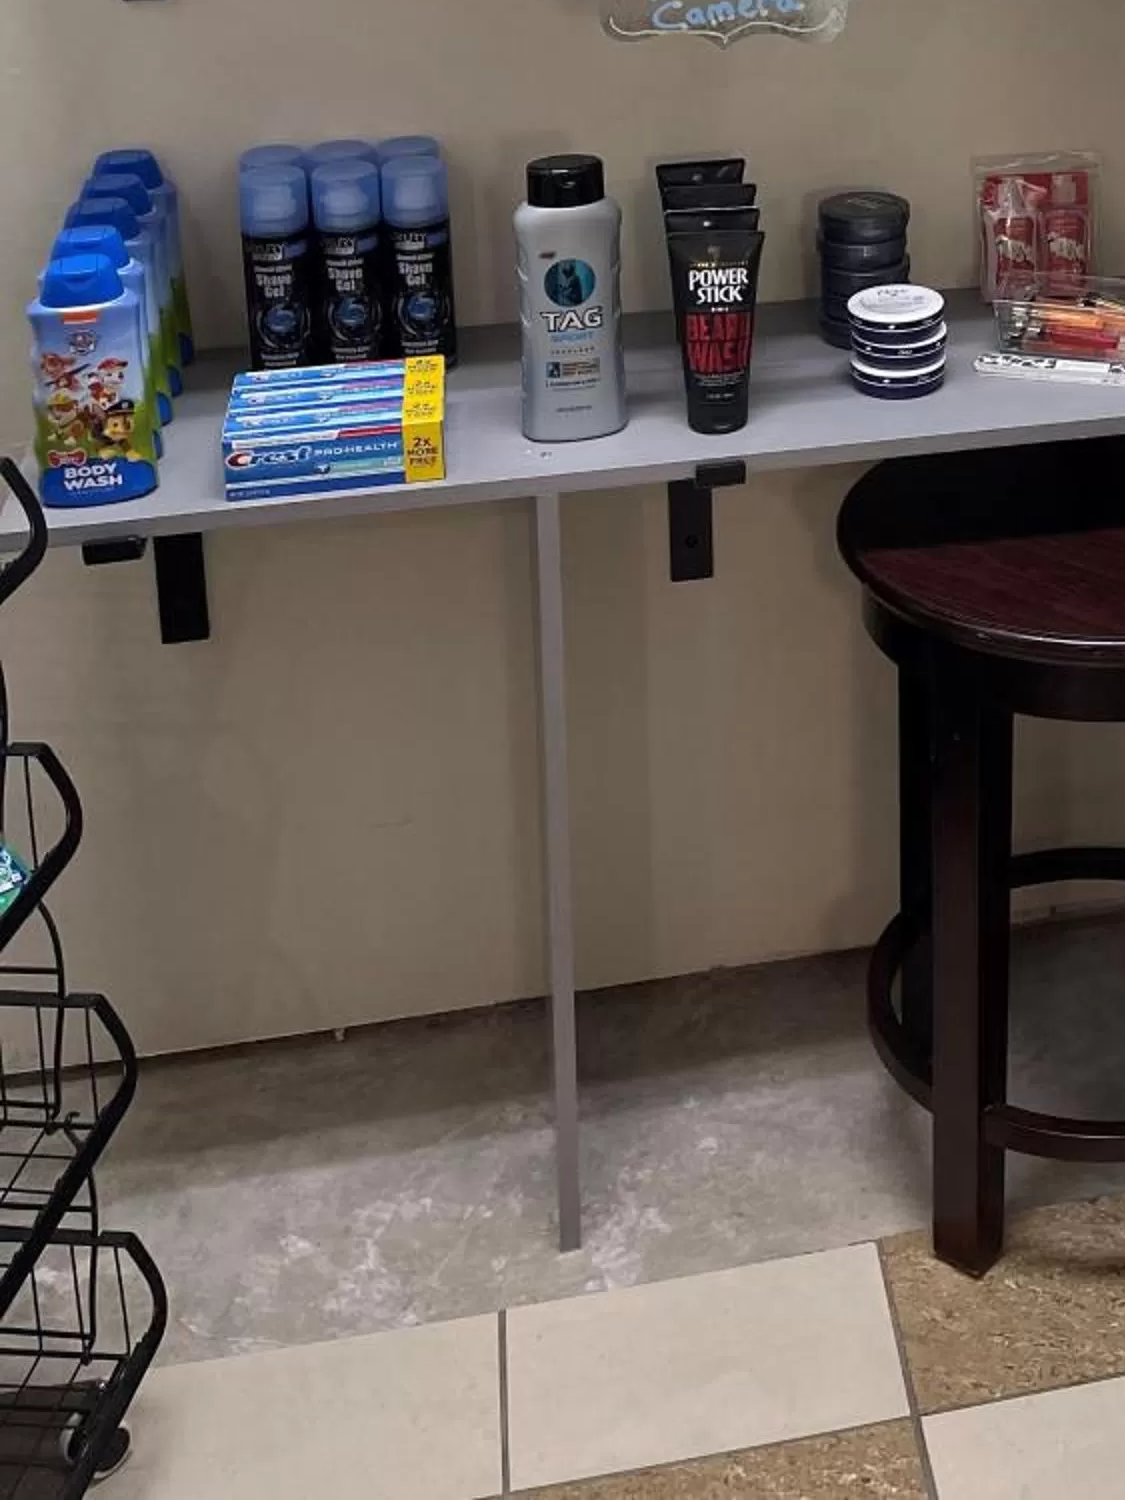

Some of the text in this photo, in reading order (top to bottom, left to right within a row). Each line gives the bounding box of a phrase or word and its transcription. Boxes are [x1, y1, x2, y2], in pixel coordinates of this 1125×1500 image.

[689, 268, 749, 291] POWER
[697, 285, 743, 305] STICK
[540, 306, 604, 333] TAG
[686, 313, 750, 341] BEARD
[688, 341, 751, 374] WASH
[225, 445, 313, 470] Crest
[63, 474, 123, 491] WASH
[64, 462, 117, 479] BODY
